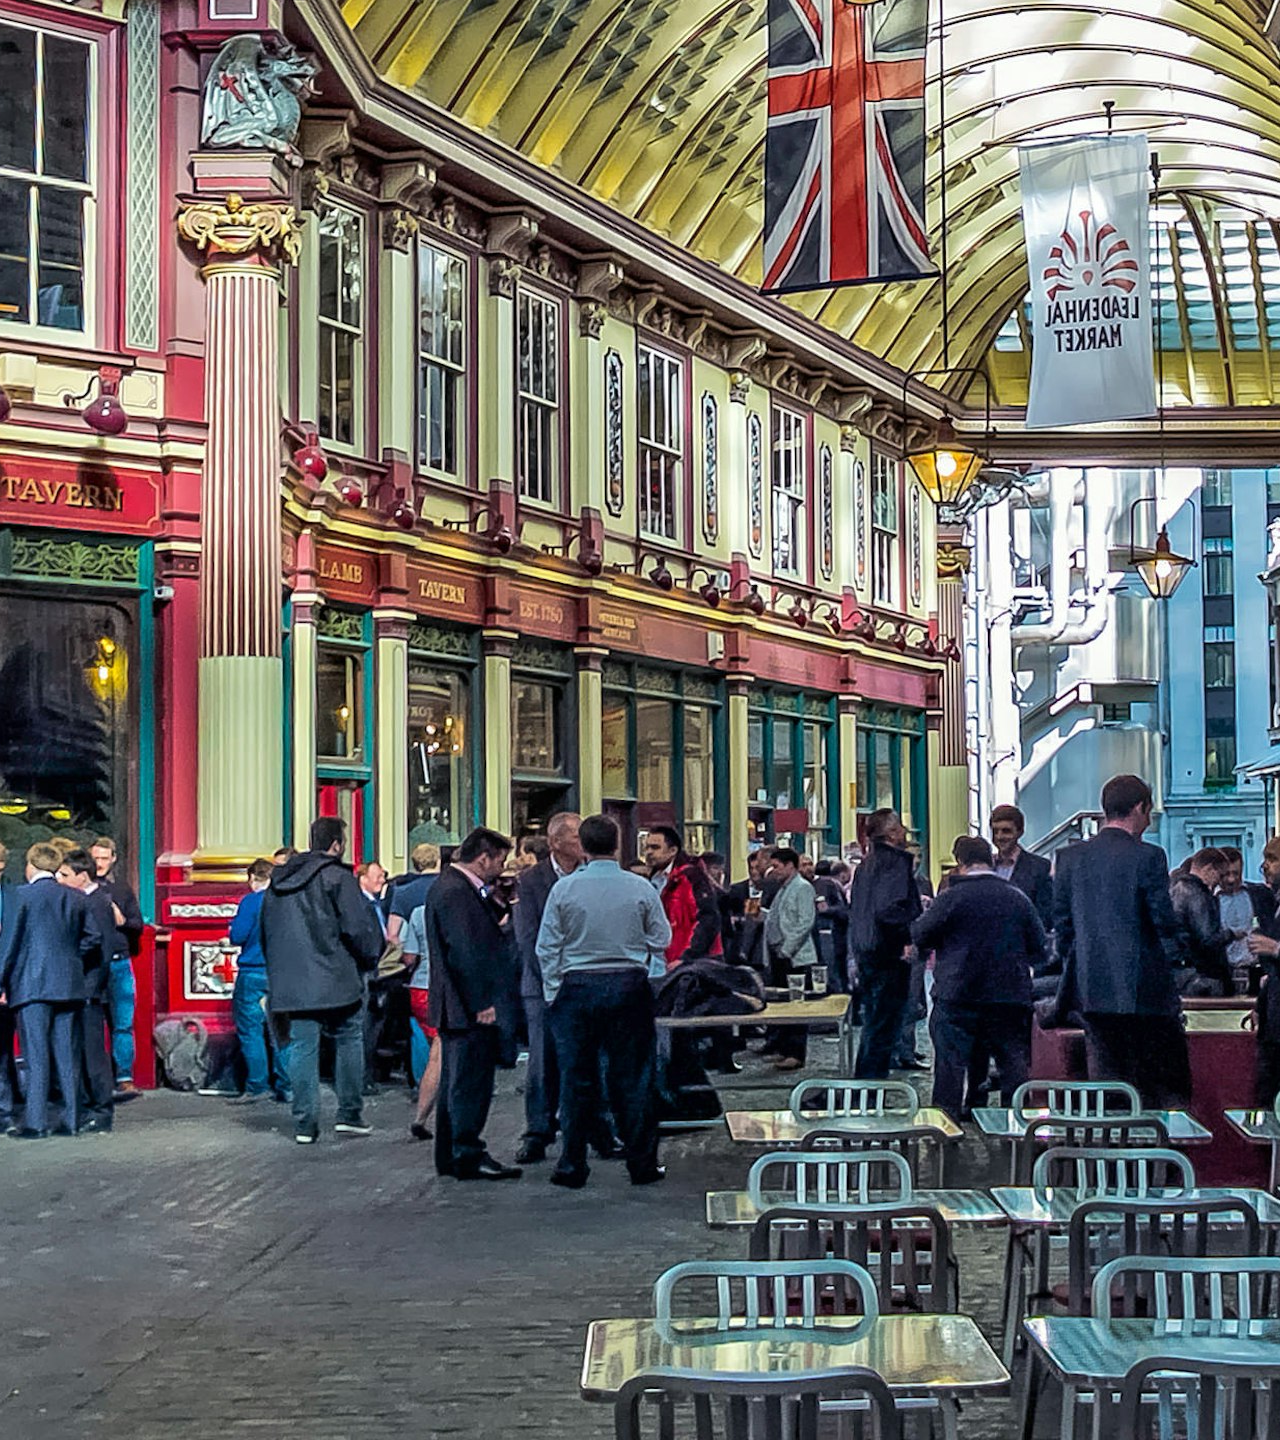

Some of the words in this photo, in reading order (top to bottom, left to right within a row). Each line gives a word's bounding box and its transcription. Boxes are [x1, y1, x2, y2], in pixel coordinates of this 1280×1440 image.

[1, 475, 124, 510] TAVERN
[320, 559, 363, 584] LAMB
[418, 579, 467, 604] TAVERN
